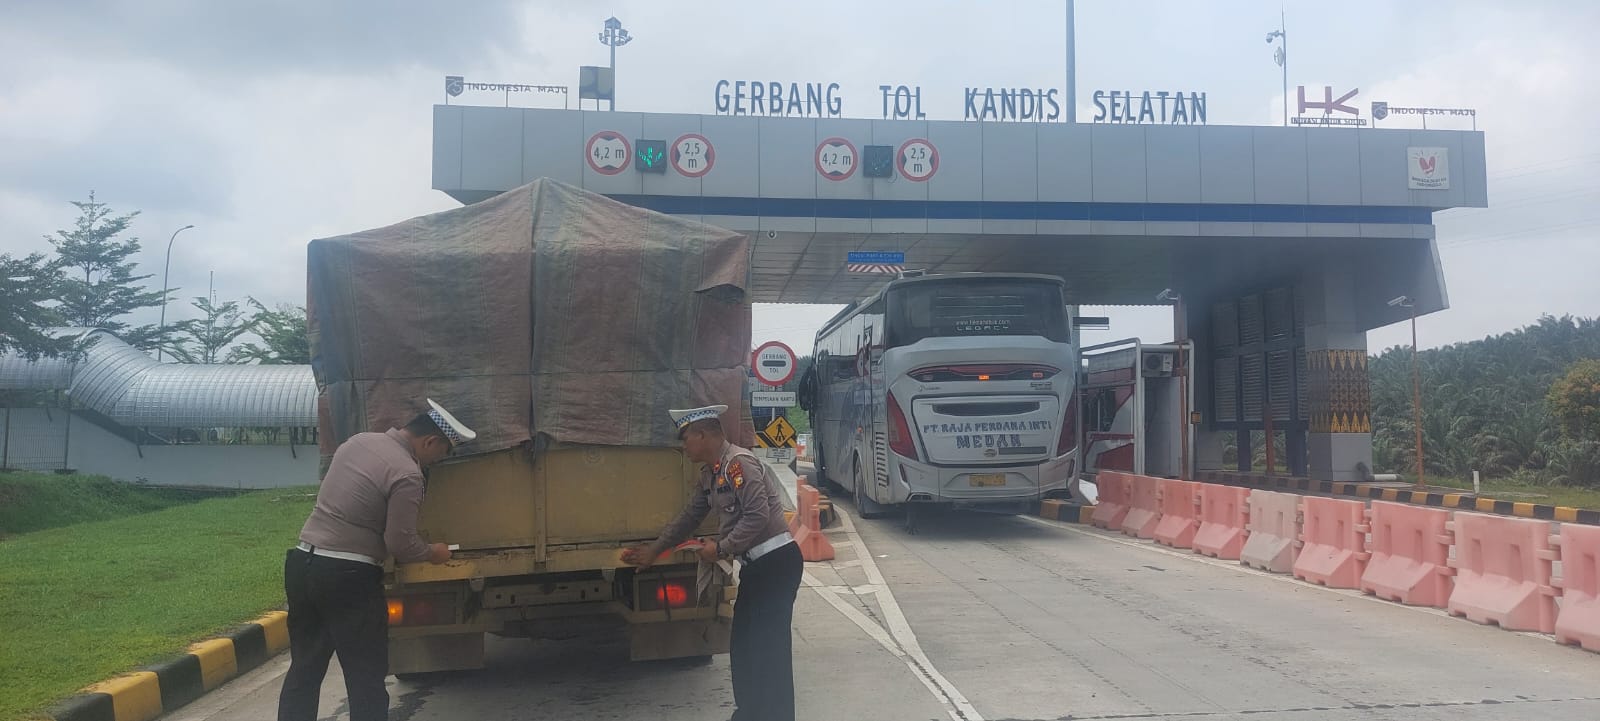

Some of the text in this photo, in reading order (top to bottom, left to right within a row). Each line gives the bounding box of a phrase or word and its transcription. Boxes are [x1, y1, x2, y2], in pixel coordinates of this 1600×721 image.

[467, 82, 568, 94] INDONESIA MAJU
[715, 79, 1207, 123] GERBANG TOL KANDIS SELATAN
[1297, 85, 1360, 116] HK
[1390, 107, 1476, 117] INDONESIA MAJU
[593, 147, 625, 161] 4,2 m
[684, 142, 700, 156] 2,5
[911, 147, 926, 161] 2,5
[688, 158, 698, 169] m
[822, 153, 851, 166] 4,2 m
[913, 162, 923, 173] m
[941, 423, 973, 433] RAJA
[974, 421, 1027, 432] PERDANA
[1029, 420, 1052, 431] INTI
[956, 433, 1022, 449] MEDAN
